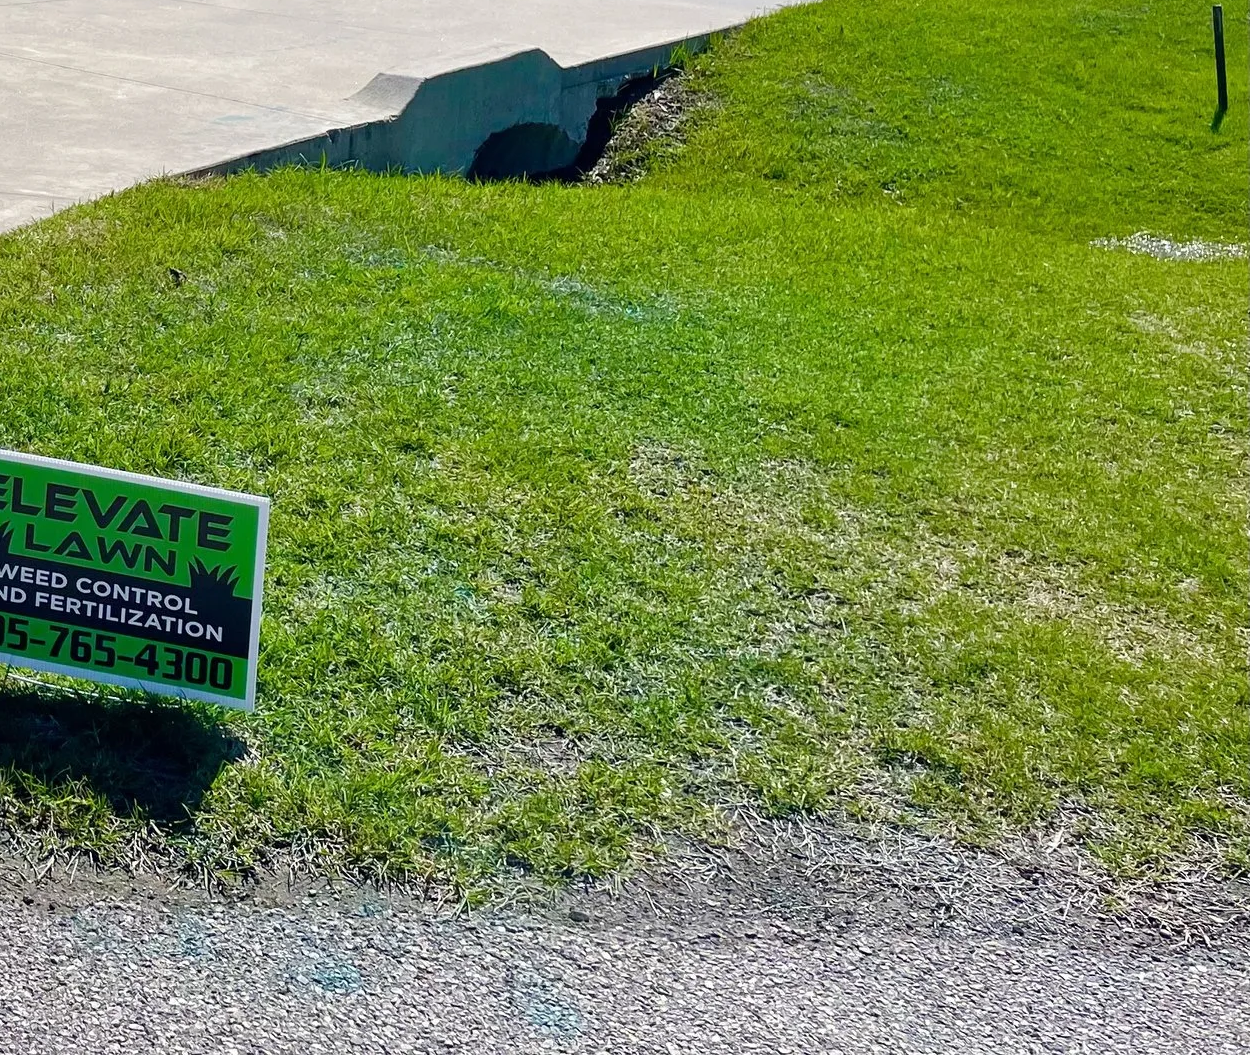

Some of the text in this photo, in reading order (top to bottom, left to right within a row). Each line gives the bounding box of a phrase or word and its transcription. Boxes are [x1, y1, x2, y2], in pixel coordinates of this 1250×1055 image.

[24, 524, 177, 577] LAWN
[35, 592, 223, 642] FERTILIZATION
[76, 577, 198, 615] CONTROL
